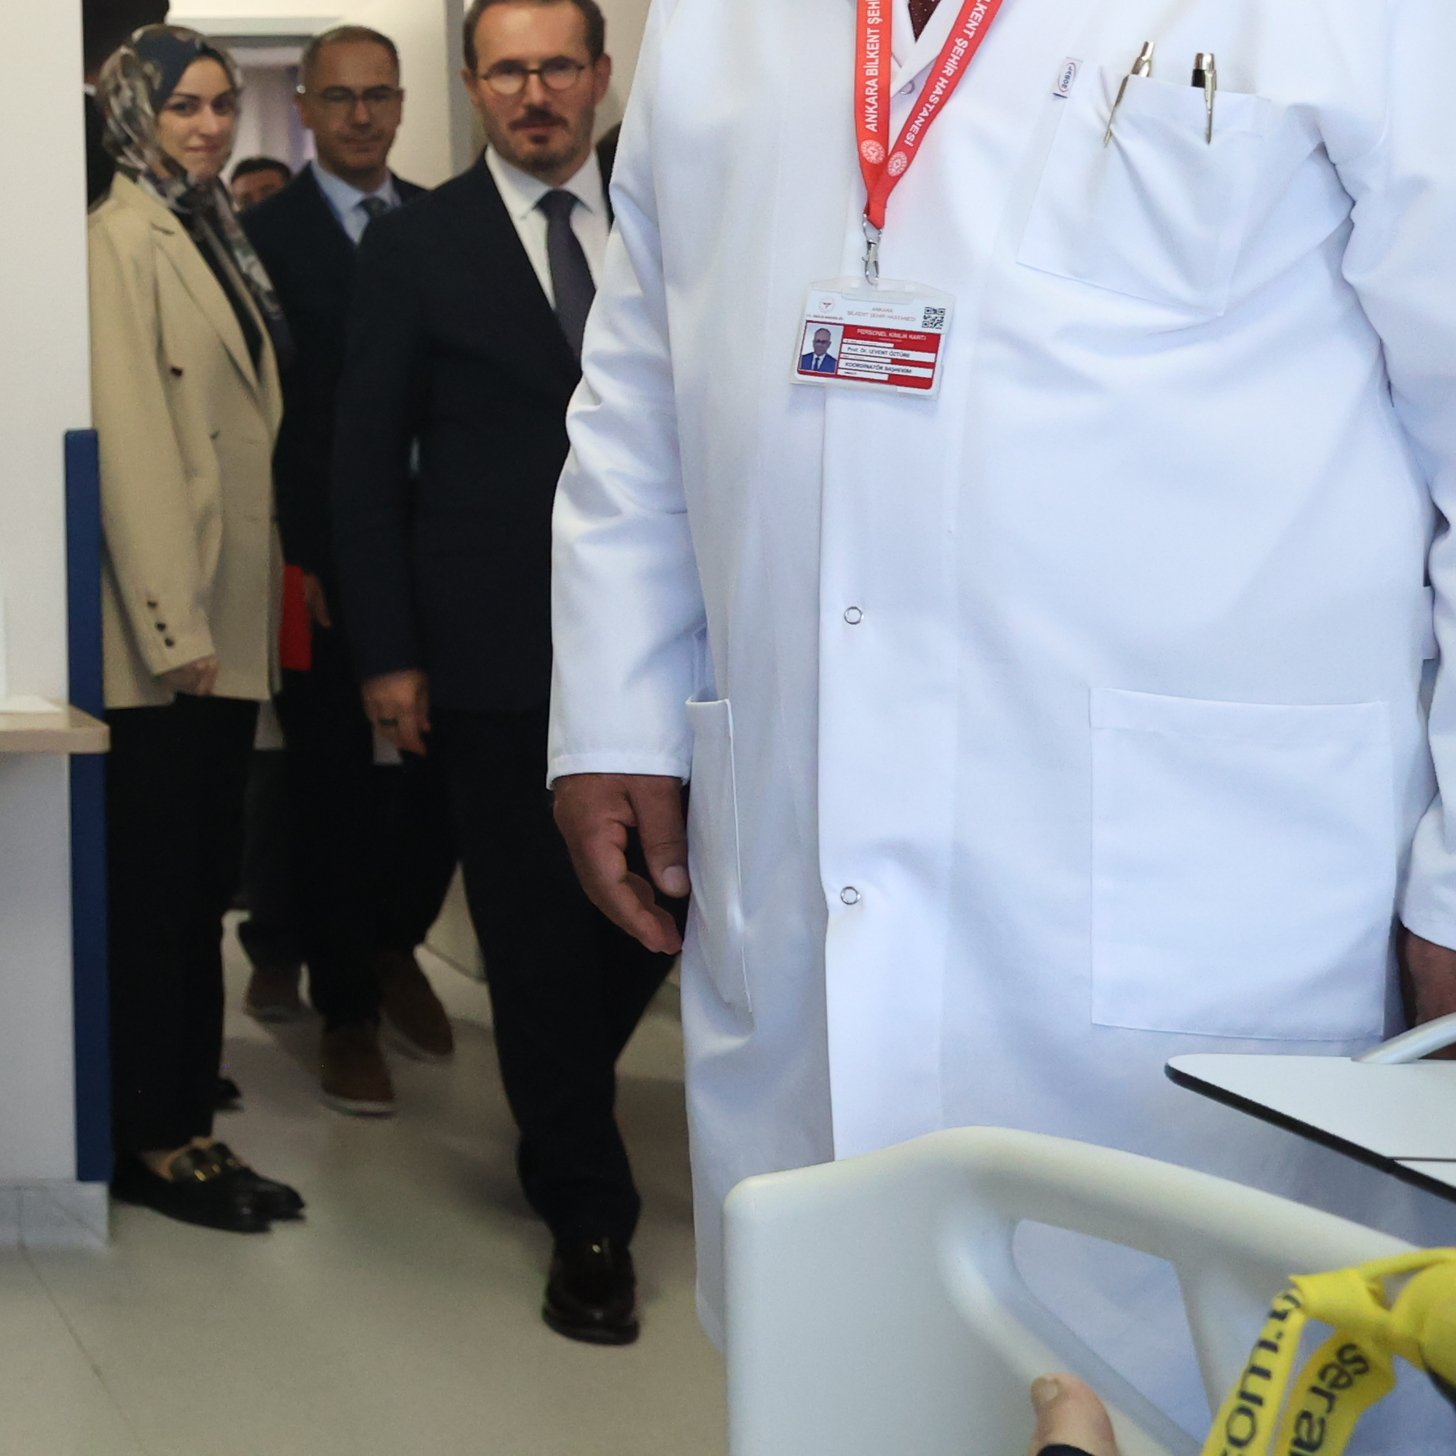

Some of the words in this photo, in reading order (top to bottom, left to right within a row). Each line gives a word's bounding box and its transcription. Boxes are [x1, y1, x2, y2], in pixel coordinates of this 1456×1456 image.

[865, 29, 881, 76] BİLKENT
[941, 33, 970, 78] ŞEHİR
[865, 78, 878, 133] ANKARA
[903, 77, 949, 148] HASTANESİ
[857, 328, 887, 337] PERSONEL
[1289, 1342, 1370, 1456] sera
